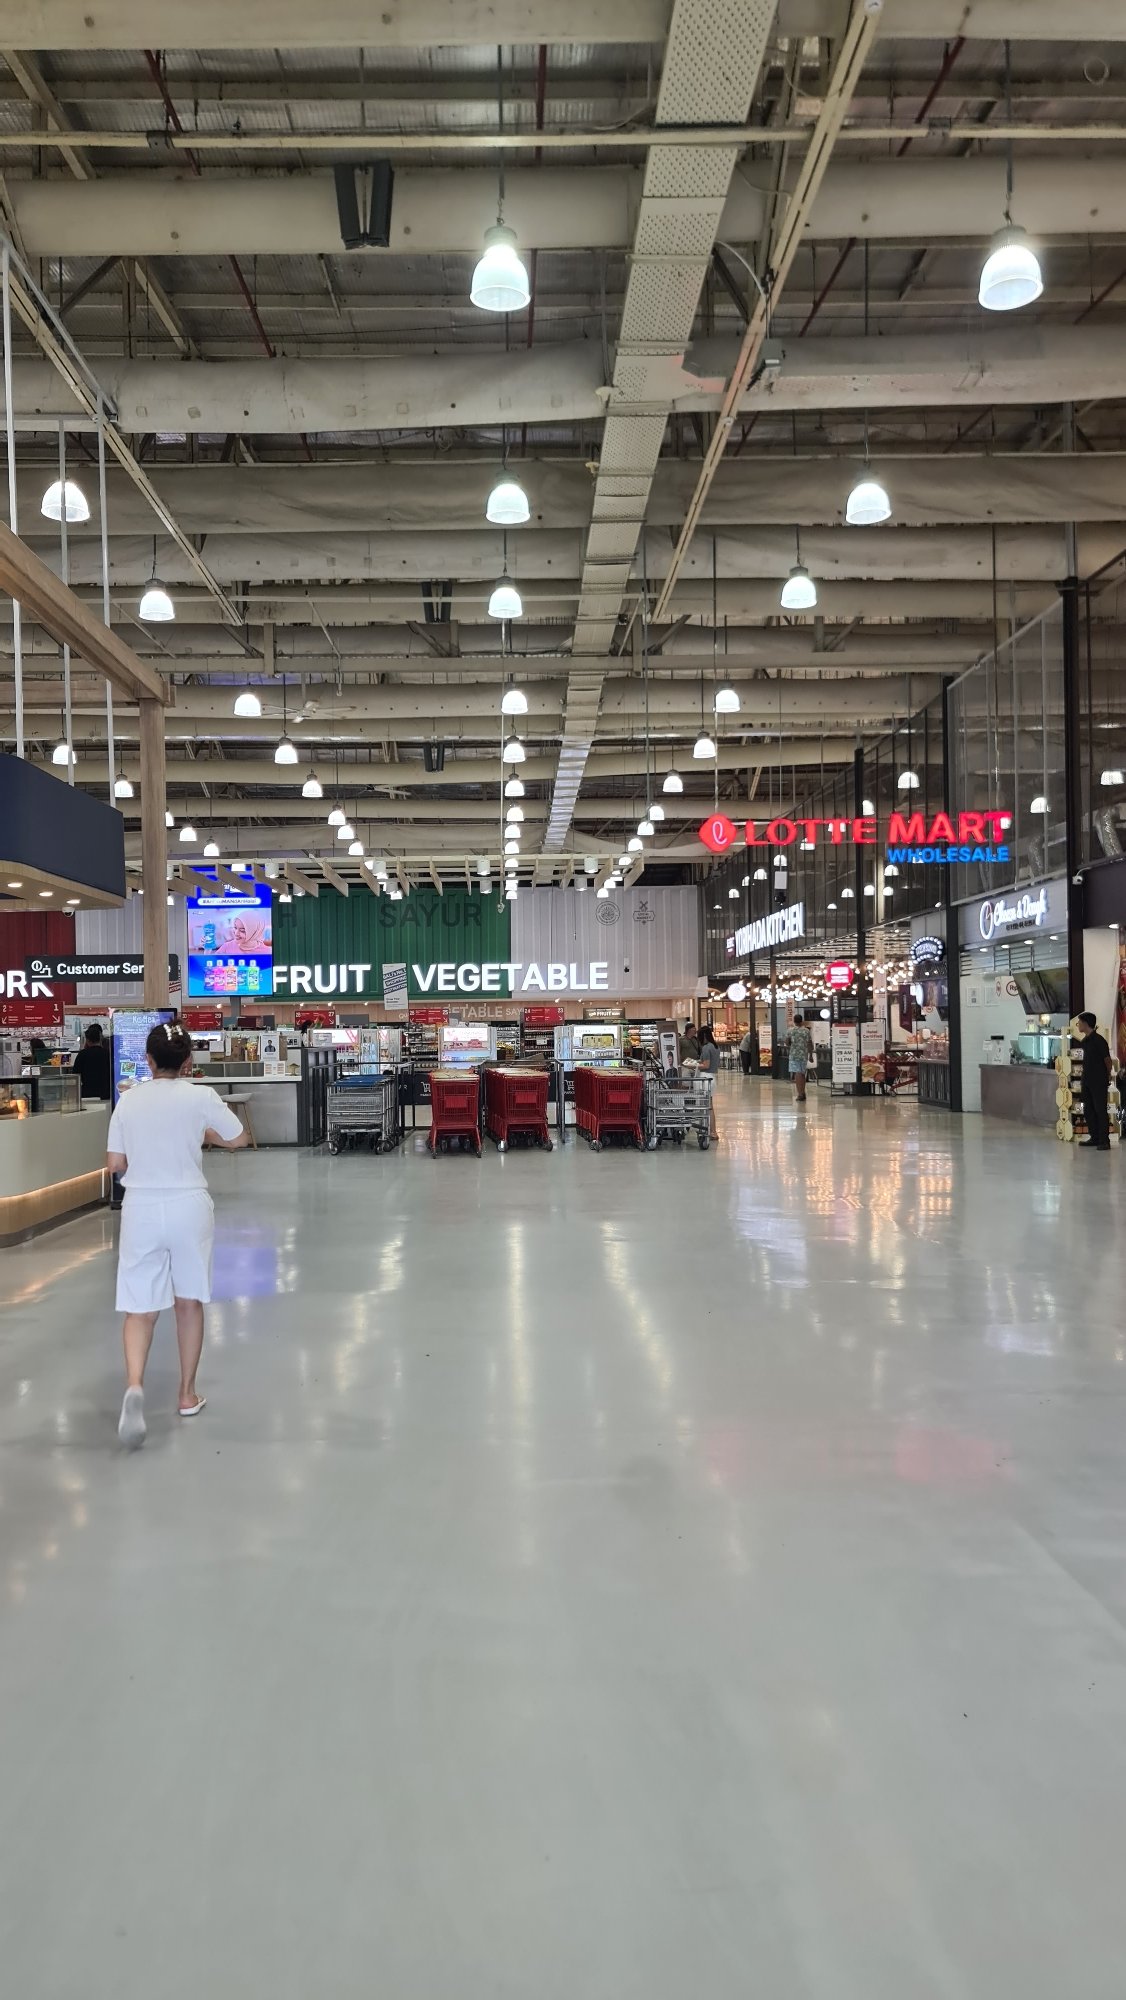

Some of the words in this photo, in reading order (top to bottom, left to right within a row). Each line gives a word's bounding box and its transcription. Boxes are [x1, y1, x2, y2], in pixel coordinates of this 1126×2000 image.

[744, 818, 878, 846] LOTTE
[888, 811, 1013, 844] MART
[888, 846, 1010, 864] WHOLESALE
[379, 903, 482, 928] SAYUR
[766, 902, 805, 947] KITCHEN
[56, 963, 120, 976] Customer
[273, 963, 371, 995] FRUIT
[412, 961, 609, 993] VEGETABLE
[53, 1003, 59, 1012] 1
